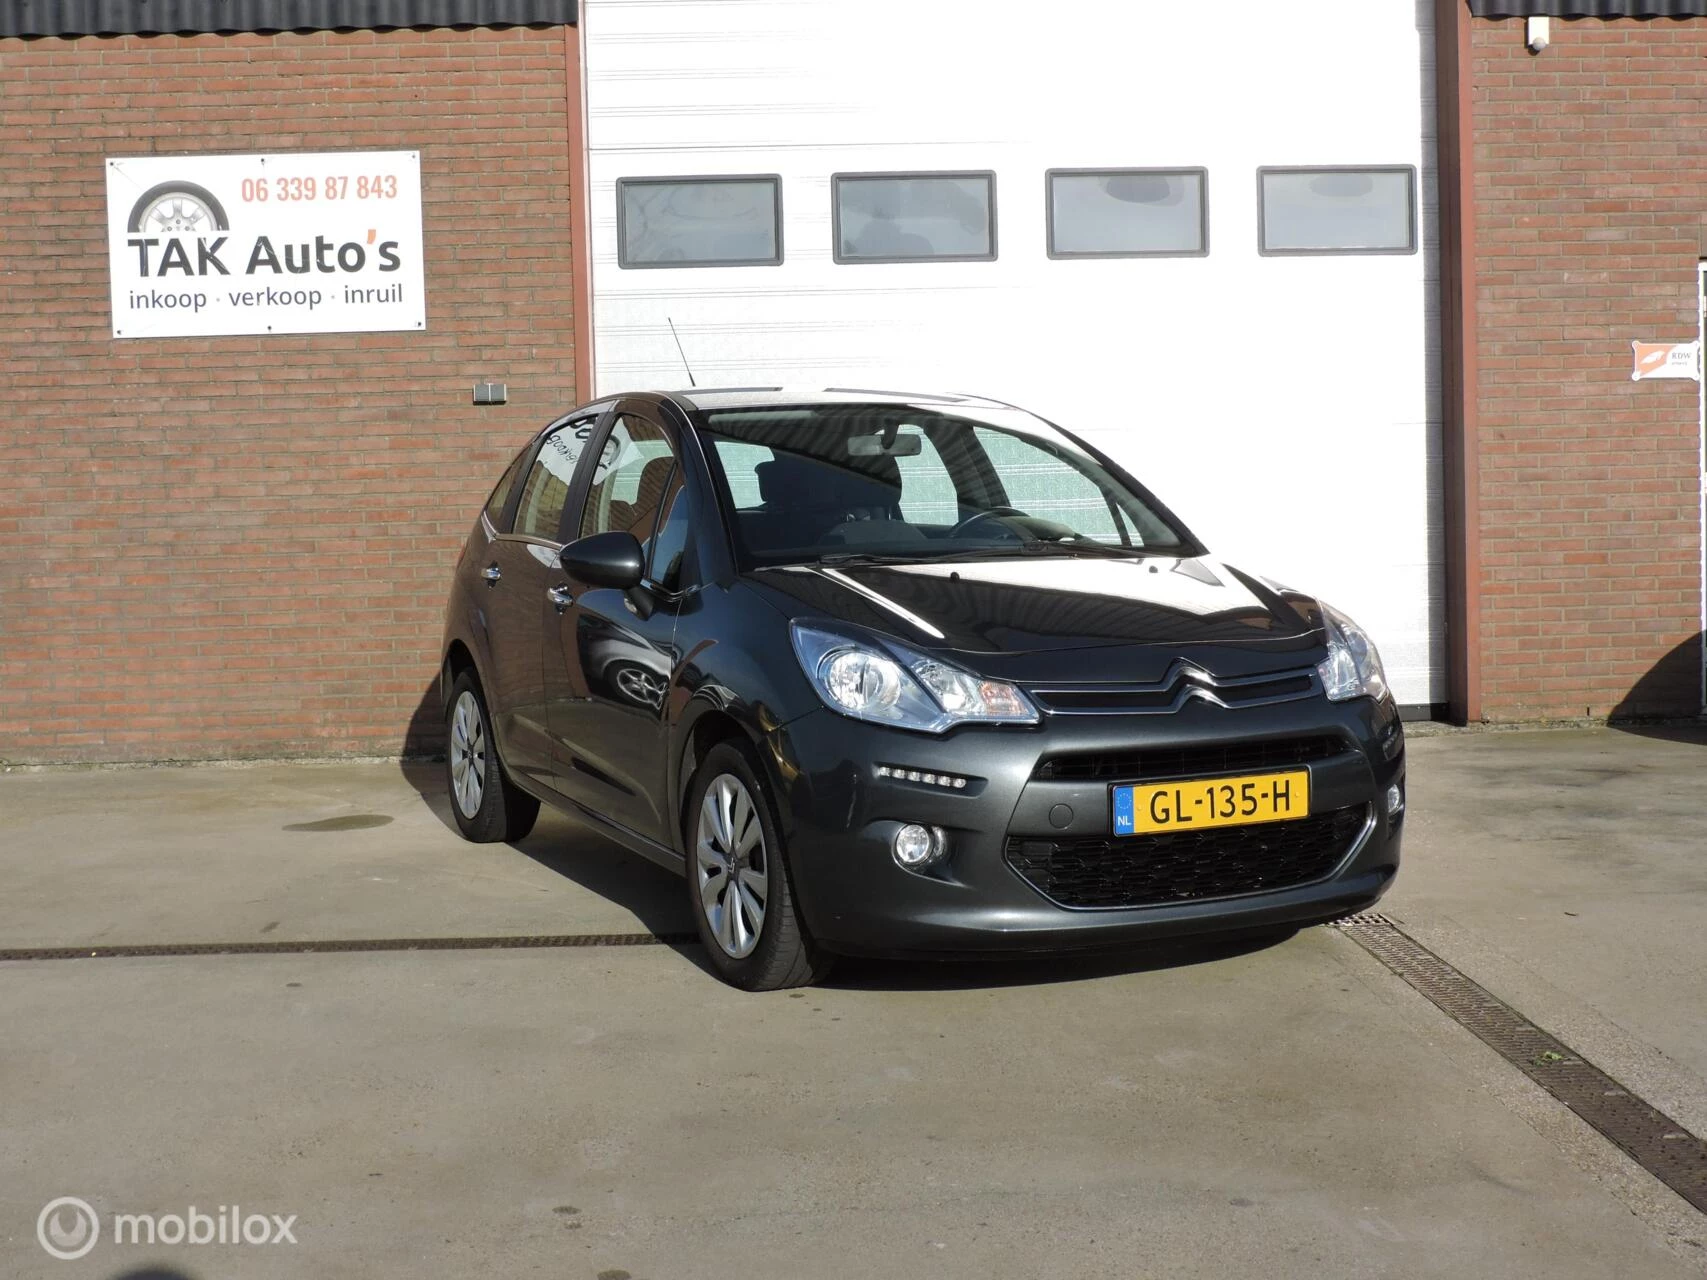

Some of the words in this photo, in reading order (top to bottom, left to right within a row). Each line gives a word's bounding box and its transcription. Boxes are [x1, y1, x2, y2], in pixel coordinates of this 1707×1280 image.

[241, 178, 268, 202] 06
[276, 177, 316, 201] 339
[325, 176, 348, 200] 87
[356, 175, 397, 199] 843
[127, 236, 231, 277] TAK
[245, 229, 401, 275] Auto's
[129, 289, 207, 312] inkoop
[229, 286, 322, 310] verkoop
[344, 283, 402, 304] inruil
[1149, 779, 1290, 824] GL-135-H
[1117, 816, 1131, 826] NL
